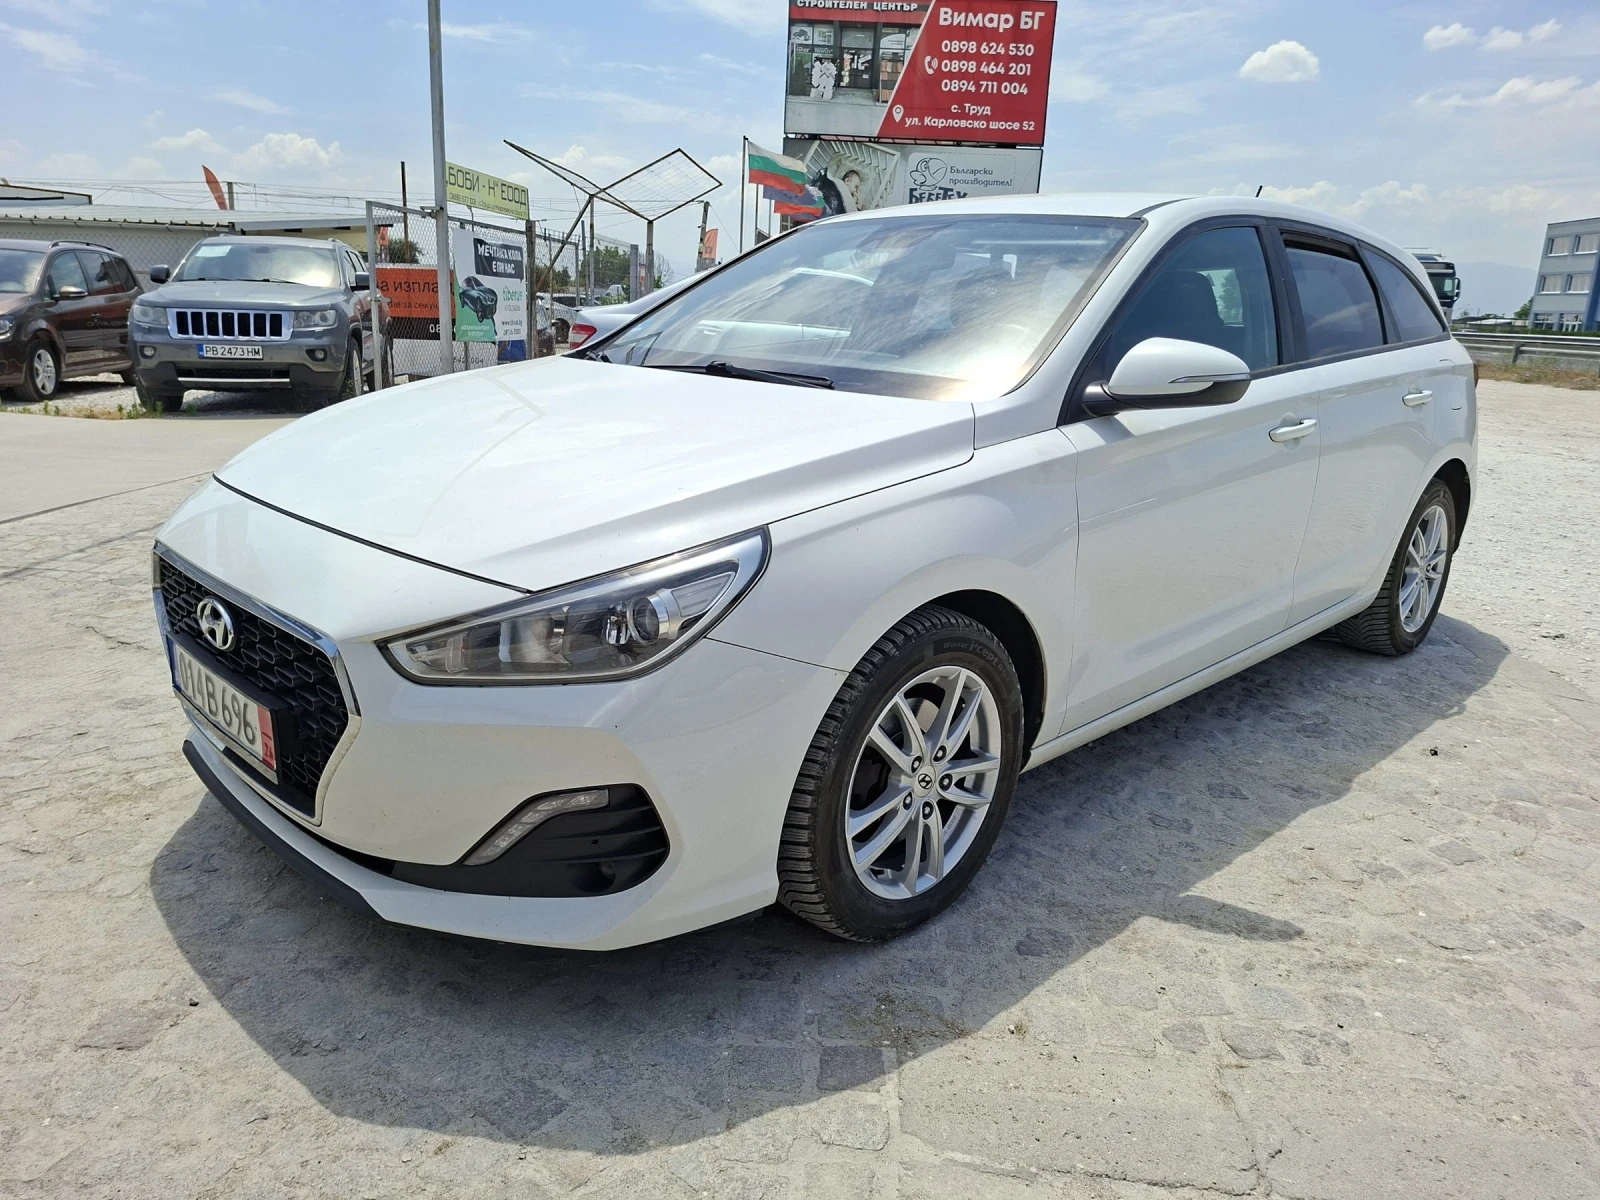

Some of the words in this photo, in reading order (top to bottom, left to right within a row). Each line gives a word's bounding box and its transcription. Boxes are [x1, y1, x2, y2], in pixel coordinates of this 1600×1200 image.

[796, 0, 868, 9] СТРОИТЕЛЕН
[873, 2, 918, 12] ЦЕНТЪР
[939, 7, 1014, 33] Вимар
[1020, 10, 1045, 30] БГ
[941, 40, 977, 54] 0898
[980, 42, 1005, 55] 624
[1008, 43, 1035, 57] 530
[941, 59, 977, 74] 0898
[979, 61, 1005, 75] 464
[1008, 62, 1031, 76] 201
[941, 79, 976, 93] 0894
[979, 81, 998, 94] 711
[1001, 82, 1028, 95] 004
[951, 104, 961, 113] с.
[964, 103, 991, 116] Труд
[905, 117, 921, 127] ул.
[924, 116, 987, 129] Карловско
[989, 120, 1020, 130] шосе
[1022, 121, 1035, 131] 52
[950, 165, 994, 177] Български
[948, 177, 1013, 188] производител!
[500, 182, 527, 210] ЕООД
[414, 302, 439, 312] секун
[205, 346, 218, 356] PB
[220, 347, 246, 357] 2473
[246, 347, 261, 357] HM
[943, 641, 968, 649] Winter
